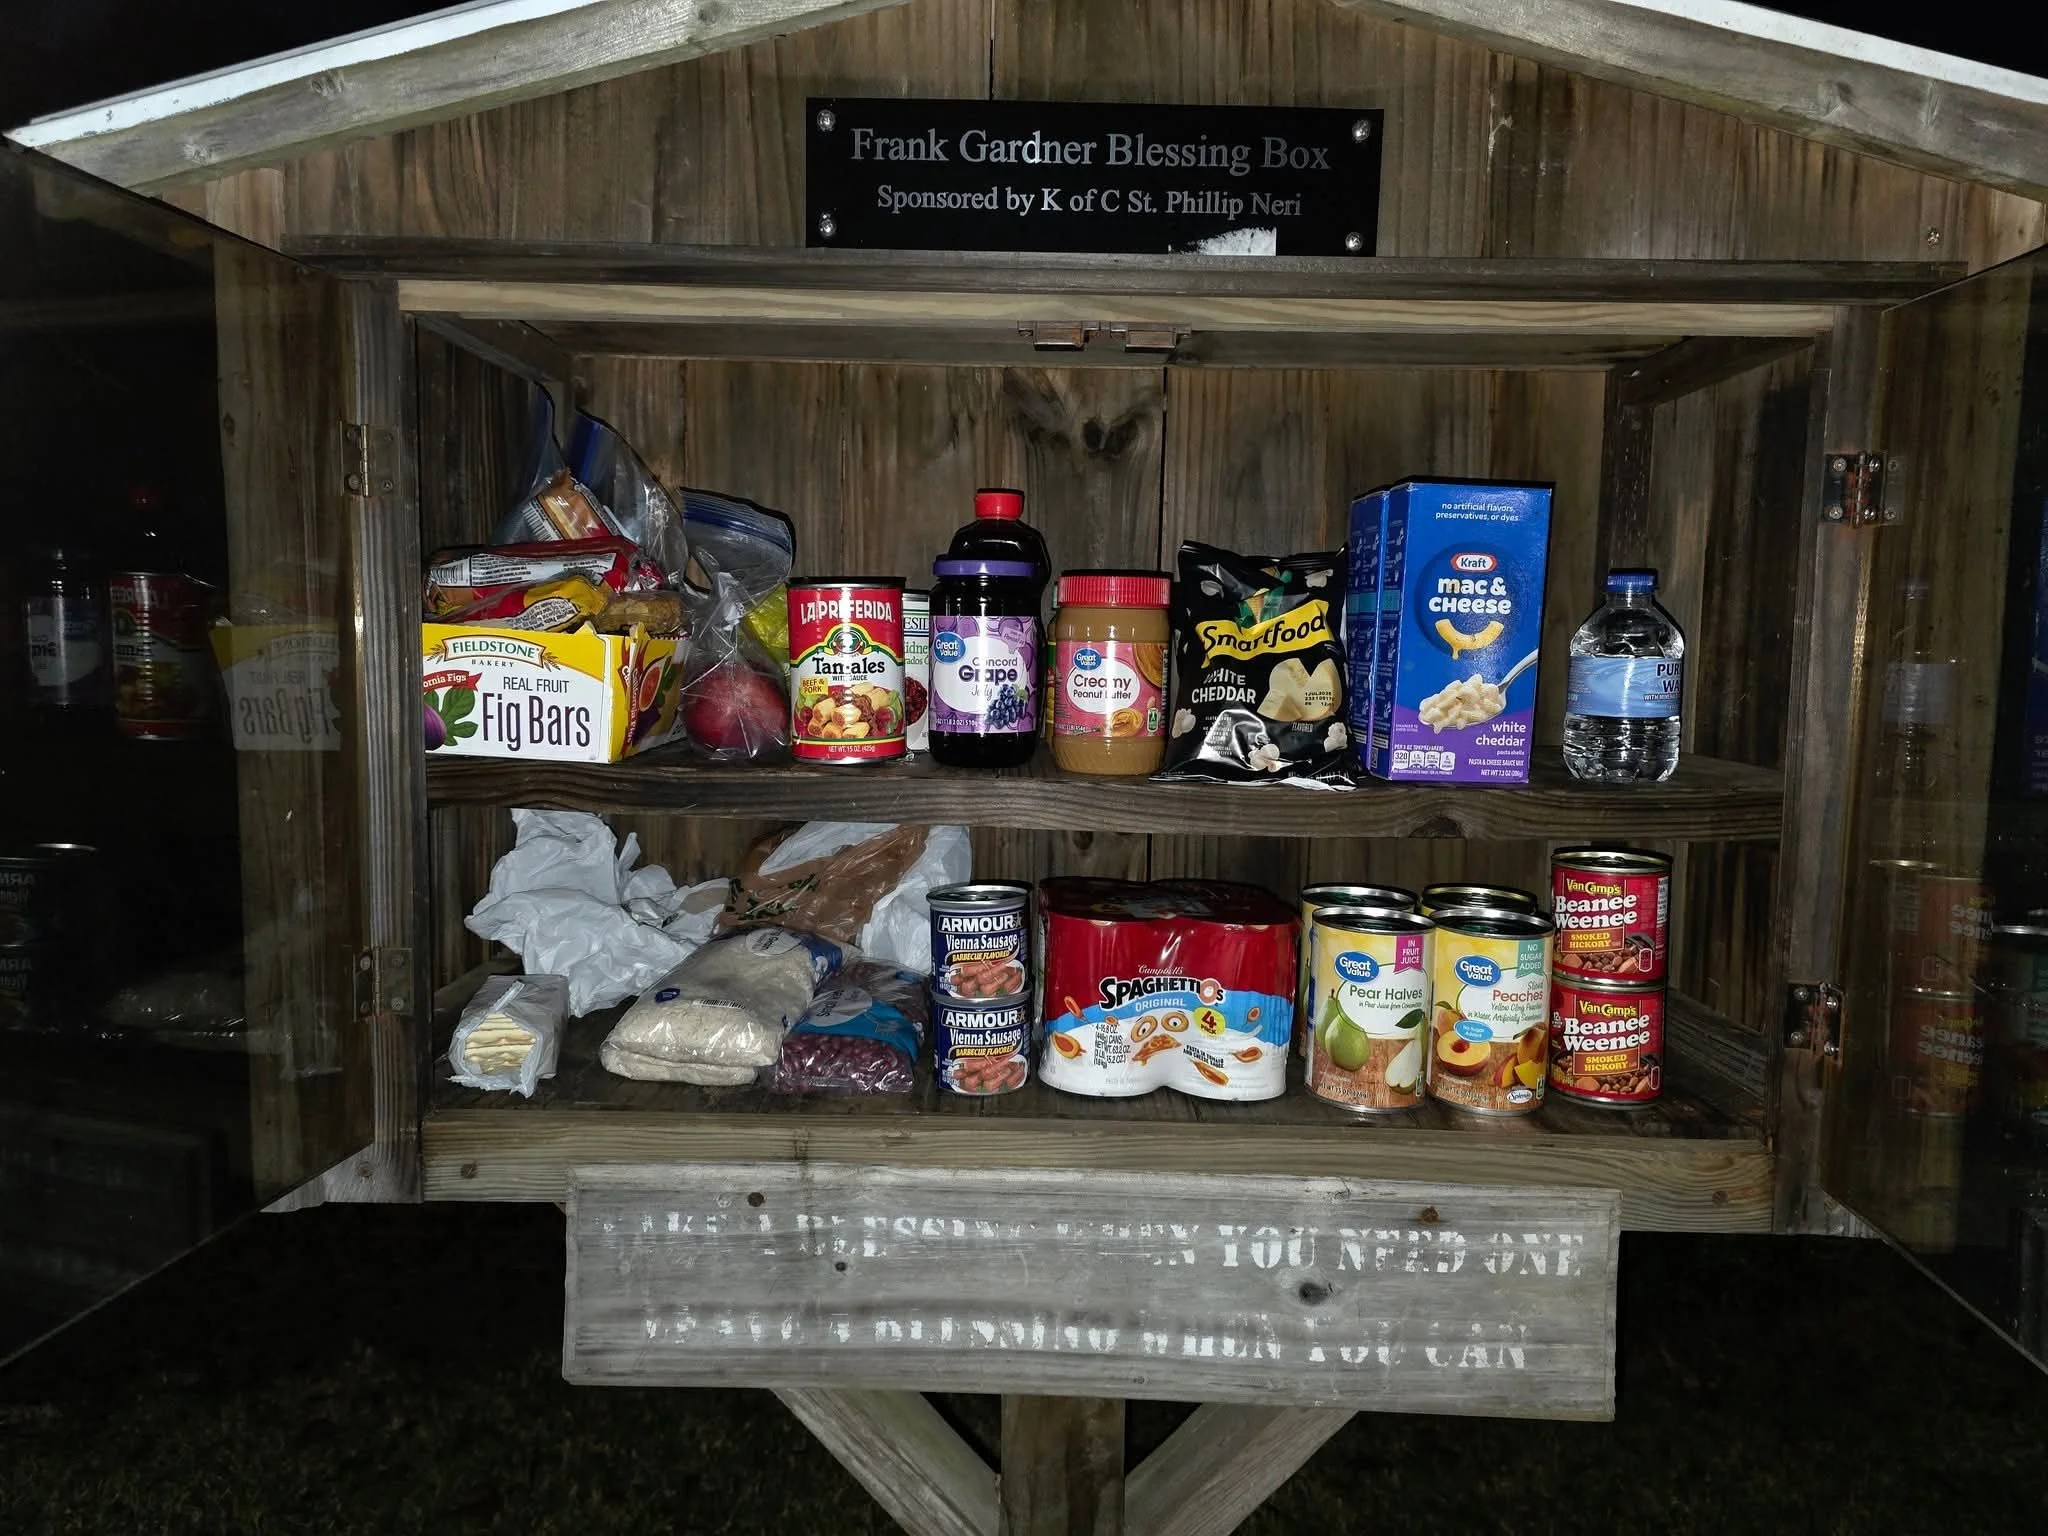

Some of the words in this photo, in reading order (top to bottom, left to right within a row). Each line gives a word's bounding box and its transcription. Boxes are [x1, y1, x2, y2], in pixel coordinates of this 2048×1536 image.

[850, 127, 949, 162] Frank
[959, 130, 1097, 166] Gardner
[1105, 133, 1251, 177] Blessing
[1260, 136, 1331, 171] Box
[877, 185, 998, 215] Sponsored
[1006, 187, 1035, 216] by
[1041, 189, 1062, 212] K
[1069, 189, 1098, 213] of
[1101, 189, 1120, 213] C
[1128, 190, 1158, 214] St.
[1165, 190, 1244, 220] Phillip
[1251, 191, 1303, 217] Neri
[1453, 503, 1485, 511] artificial
[1436, 512, 1490, 520] preservatives,
[1460, 558, 1486, 568] Kraft
[1437, 577, 1488, 594] mac
[1490, 577, 1507, 596] &
[800, 601, 816, 624] LA
[818, 599, 893, 623] PRFERIDA
[1201, 615, 1325, 653] Smartfood
[452, 640, 536, 658] FIELDSTONE
[935, 640, 959, 650] Great
[972, 657, 1018, 667] Cncord
[1076, 653, 1096, 661] Great
[472, 659, 514, 668] BAKERY
[447, 673, 467, 684] Figs
[958, 665, 1018, 686] Grape
[1203, 667, 1246, 686] WHITE
[503, 676, 533, 692] REAL
[536, 678, 569, 694] FRUIT
[802, 679, 818, 687] BEEF
[804, 686, 822, 694] PORK
[971, 684, 993, 701] Jely
[1073, 689, 1102, 698] Peanut
[1105, 690, 1131, 699] utter
[1191, 686, 1256, 704] CHEDDAR
[482, 692, 521, 751] Fig
[529, 695, 590, 748] Bars
[1491, 721, 1526, 733] white
[1476, 734, 1526, 746] cheddar
[1395, 752, 1407, 760] 320
[1555, 894, 1637, 912] Beanee
[941, 914, 1014, 931] ARMOUR
[1554, 911, 1638, 928] Weenee
[1570, 932, 1610, 940] SMOKED
[946, 934, 980, 951] Vienna
[981, 933, 1018, 952] Sausage
[1570, 940, 1612, 949] HICKORY
[952, 951, 983, 961] BARBECUE
[983, 950, 1010, 960] FLAVORED
[1402, 948, 1419, 956] FRUIT
[1520, 953, 1541, 961] SUGAR
[1339, 957, 1371, 971] Great
[1400, 957, 1419, 965] JUICE
[1520, 962, 1541, 970] ADDED
[1346, 966, 1371, 978] Value
[1460, 961, 1493, 975] Great
[1467, 971, 1493, 982] Value
[1349, 985, 1381, 1000] Pear
[1385, 988, 1423, 1001] Halves
[1492, 990, 1543, 1002] Peaches
[1135, 998, 1187, 1012] ORIGINAL
[1491, 1003, 1509, 1011] Yellow
[945, 1011, 1018, 1028] ARMOUR
[1201, 1010, 1217, 1028] 4
[1564, 1014, 1650, 1035] Beanee
[950, 1029, 984, 1046] Vienna
[985, 1028, 1022, 1046] Sausage
[1563, 1030, 1650, 1051] Weenee
[955, 1047, 985, 1057] BARBECUE
[985, 1045, 1014, 1056] FLAVORED
[1585, 1054, 1627, 1064] SMOKED
[1584, 1061, 1628, 1072] HICKORY
[1217, 1224, 1319, 1270] YOU
[1337, 1228, 1468, 1275] NEED
[1483, 1231, 1584, 1278] ONE
[1425, 1320, 1525, 1369] CAN
